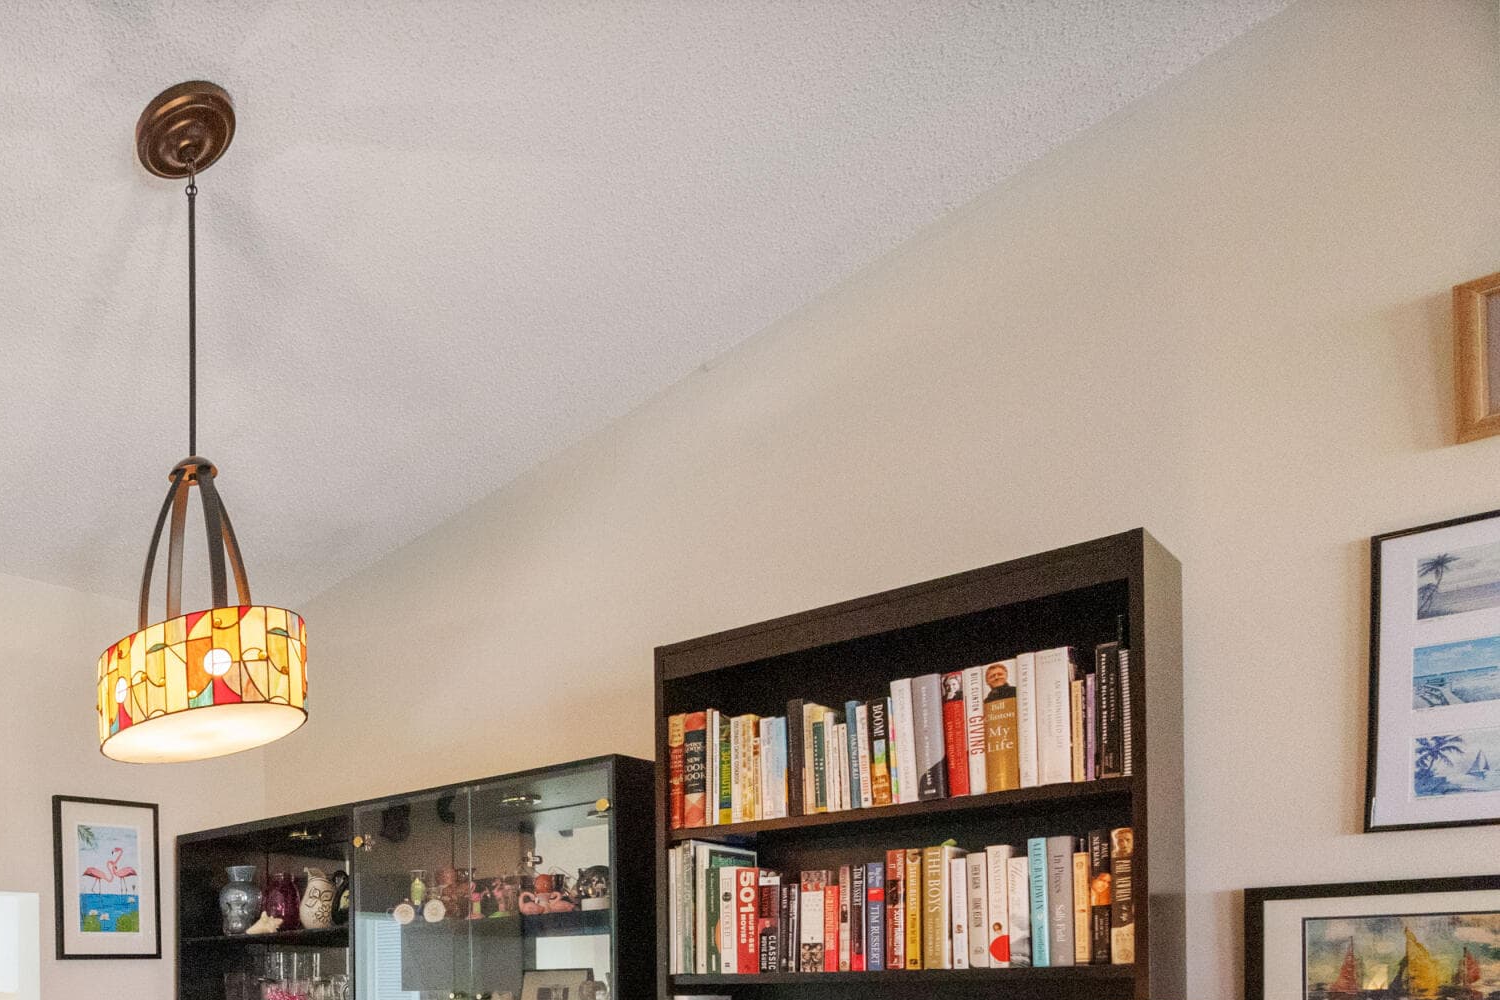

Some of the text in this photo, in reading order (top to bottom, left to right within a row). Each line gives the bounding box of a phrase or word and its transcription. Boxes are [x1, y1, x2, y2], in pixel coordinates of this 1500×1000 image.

[970, 672, 980, 712] BILL CLINTON
[991, 702, 1005, 711] Bill
[872, 704, 885, 737] BOOM!
[969, 715, 986, 756] GIVING
[988, 727, 1010, 739] My
[987, 738, 1015, 753] Life
[927, 849, 941, 879] THE
[1033, 841, 1042, 866] ALEC
[1092, 836, 1100, 867] NEWMAN
[1101, 843, 1109, 859] PAUL
[740, 871, 755, 913] 501
[853, 867, 863, 907] TIM RUSSERT
[909, 866, 917, 886] STEVE
[1034, 867, 1044, 912] BALDWIN
[1115, 860, 1132, 903] PAUL NEWMAN
[927, 879, 942, 913] BOYS
[972, 864, 983, 928] THEN AGAIN DIANE KEATON
[1053, 854, 1065, 943] In Pieces Sally Field
[870, 905, 880, 965] TIM RUSSERT
[768, 935, 777, 971] CLASSIC
